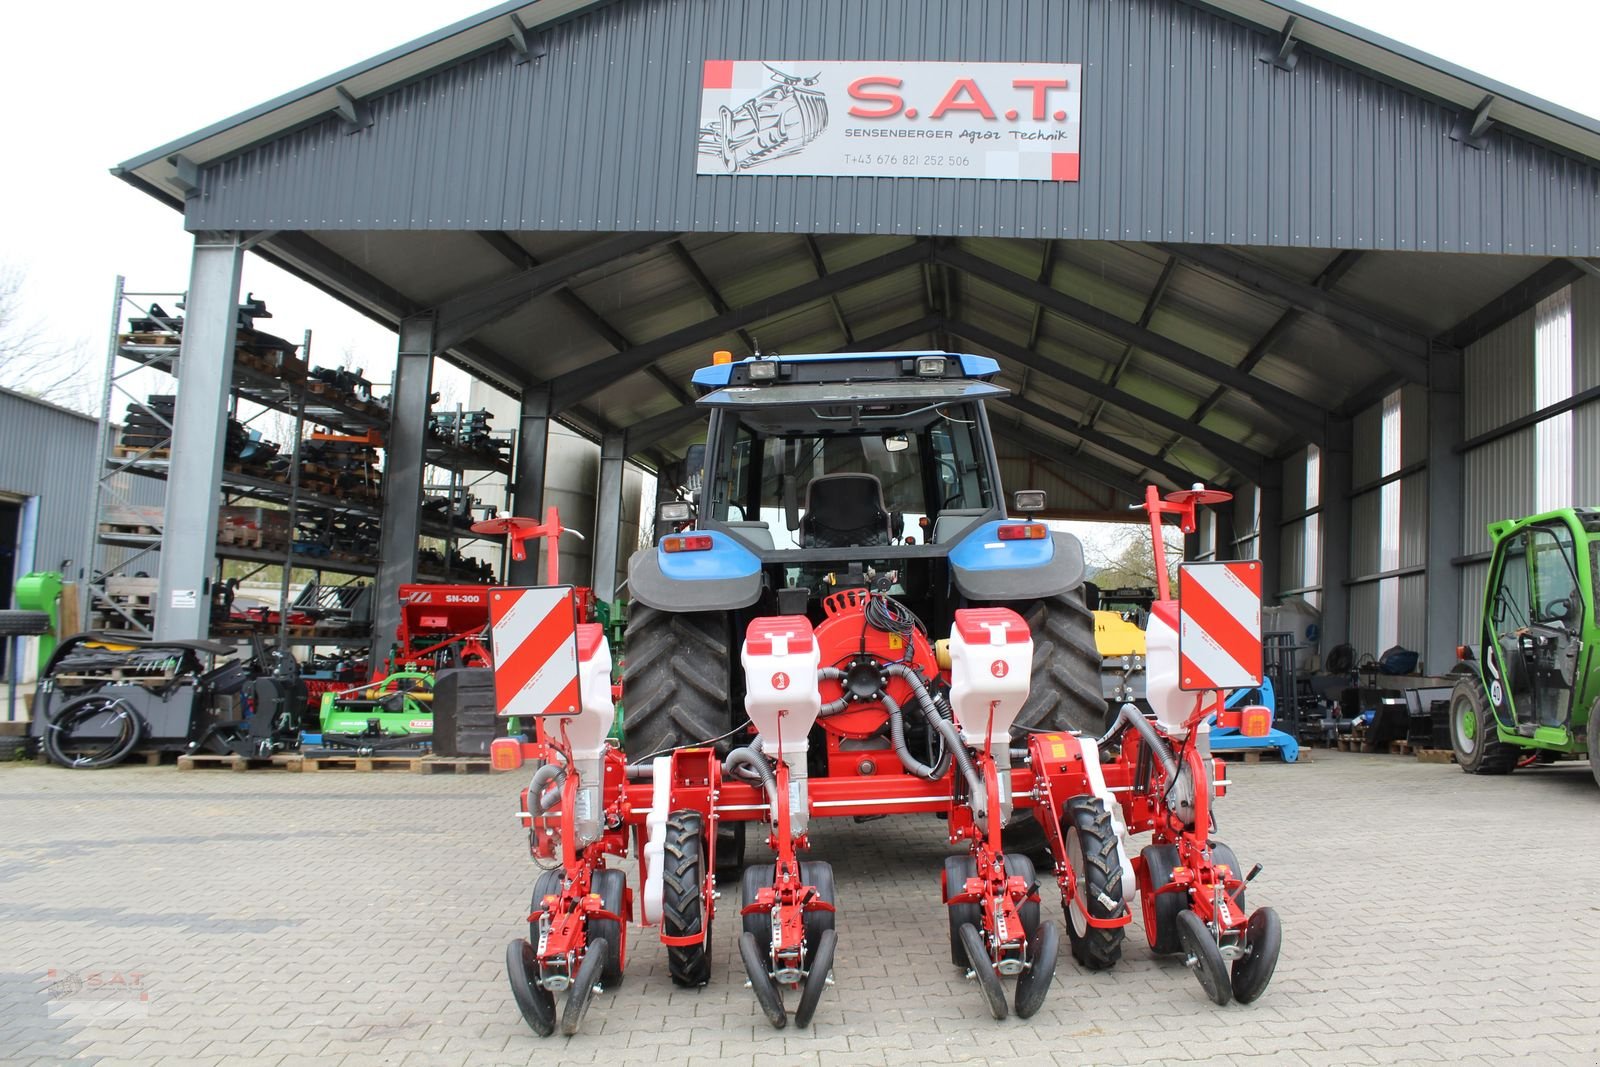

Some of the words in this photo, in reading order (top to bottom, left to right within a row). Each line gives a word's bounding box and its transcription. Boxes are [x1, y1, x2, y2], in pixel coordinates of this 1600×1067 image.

[847, 76, 1068, 120] S.A.T.
[845, 129, 953, 138] SENSENBERGER
[959, 130, 1001, 143] Agrar
[1009, 130, 1067, 142] Technik
[845, 154, 871, 164] T+43
[877, 154, 897, 165] 676
[903, 155, 919, 165] 821
[924, 155, 944, 166] 252
[949, 157, 969, 167] 506
[445, 595, 480, 603] SN-300
[1493, 686, 1500, 701] 40
